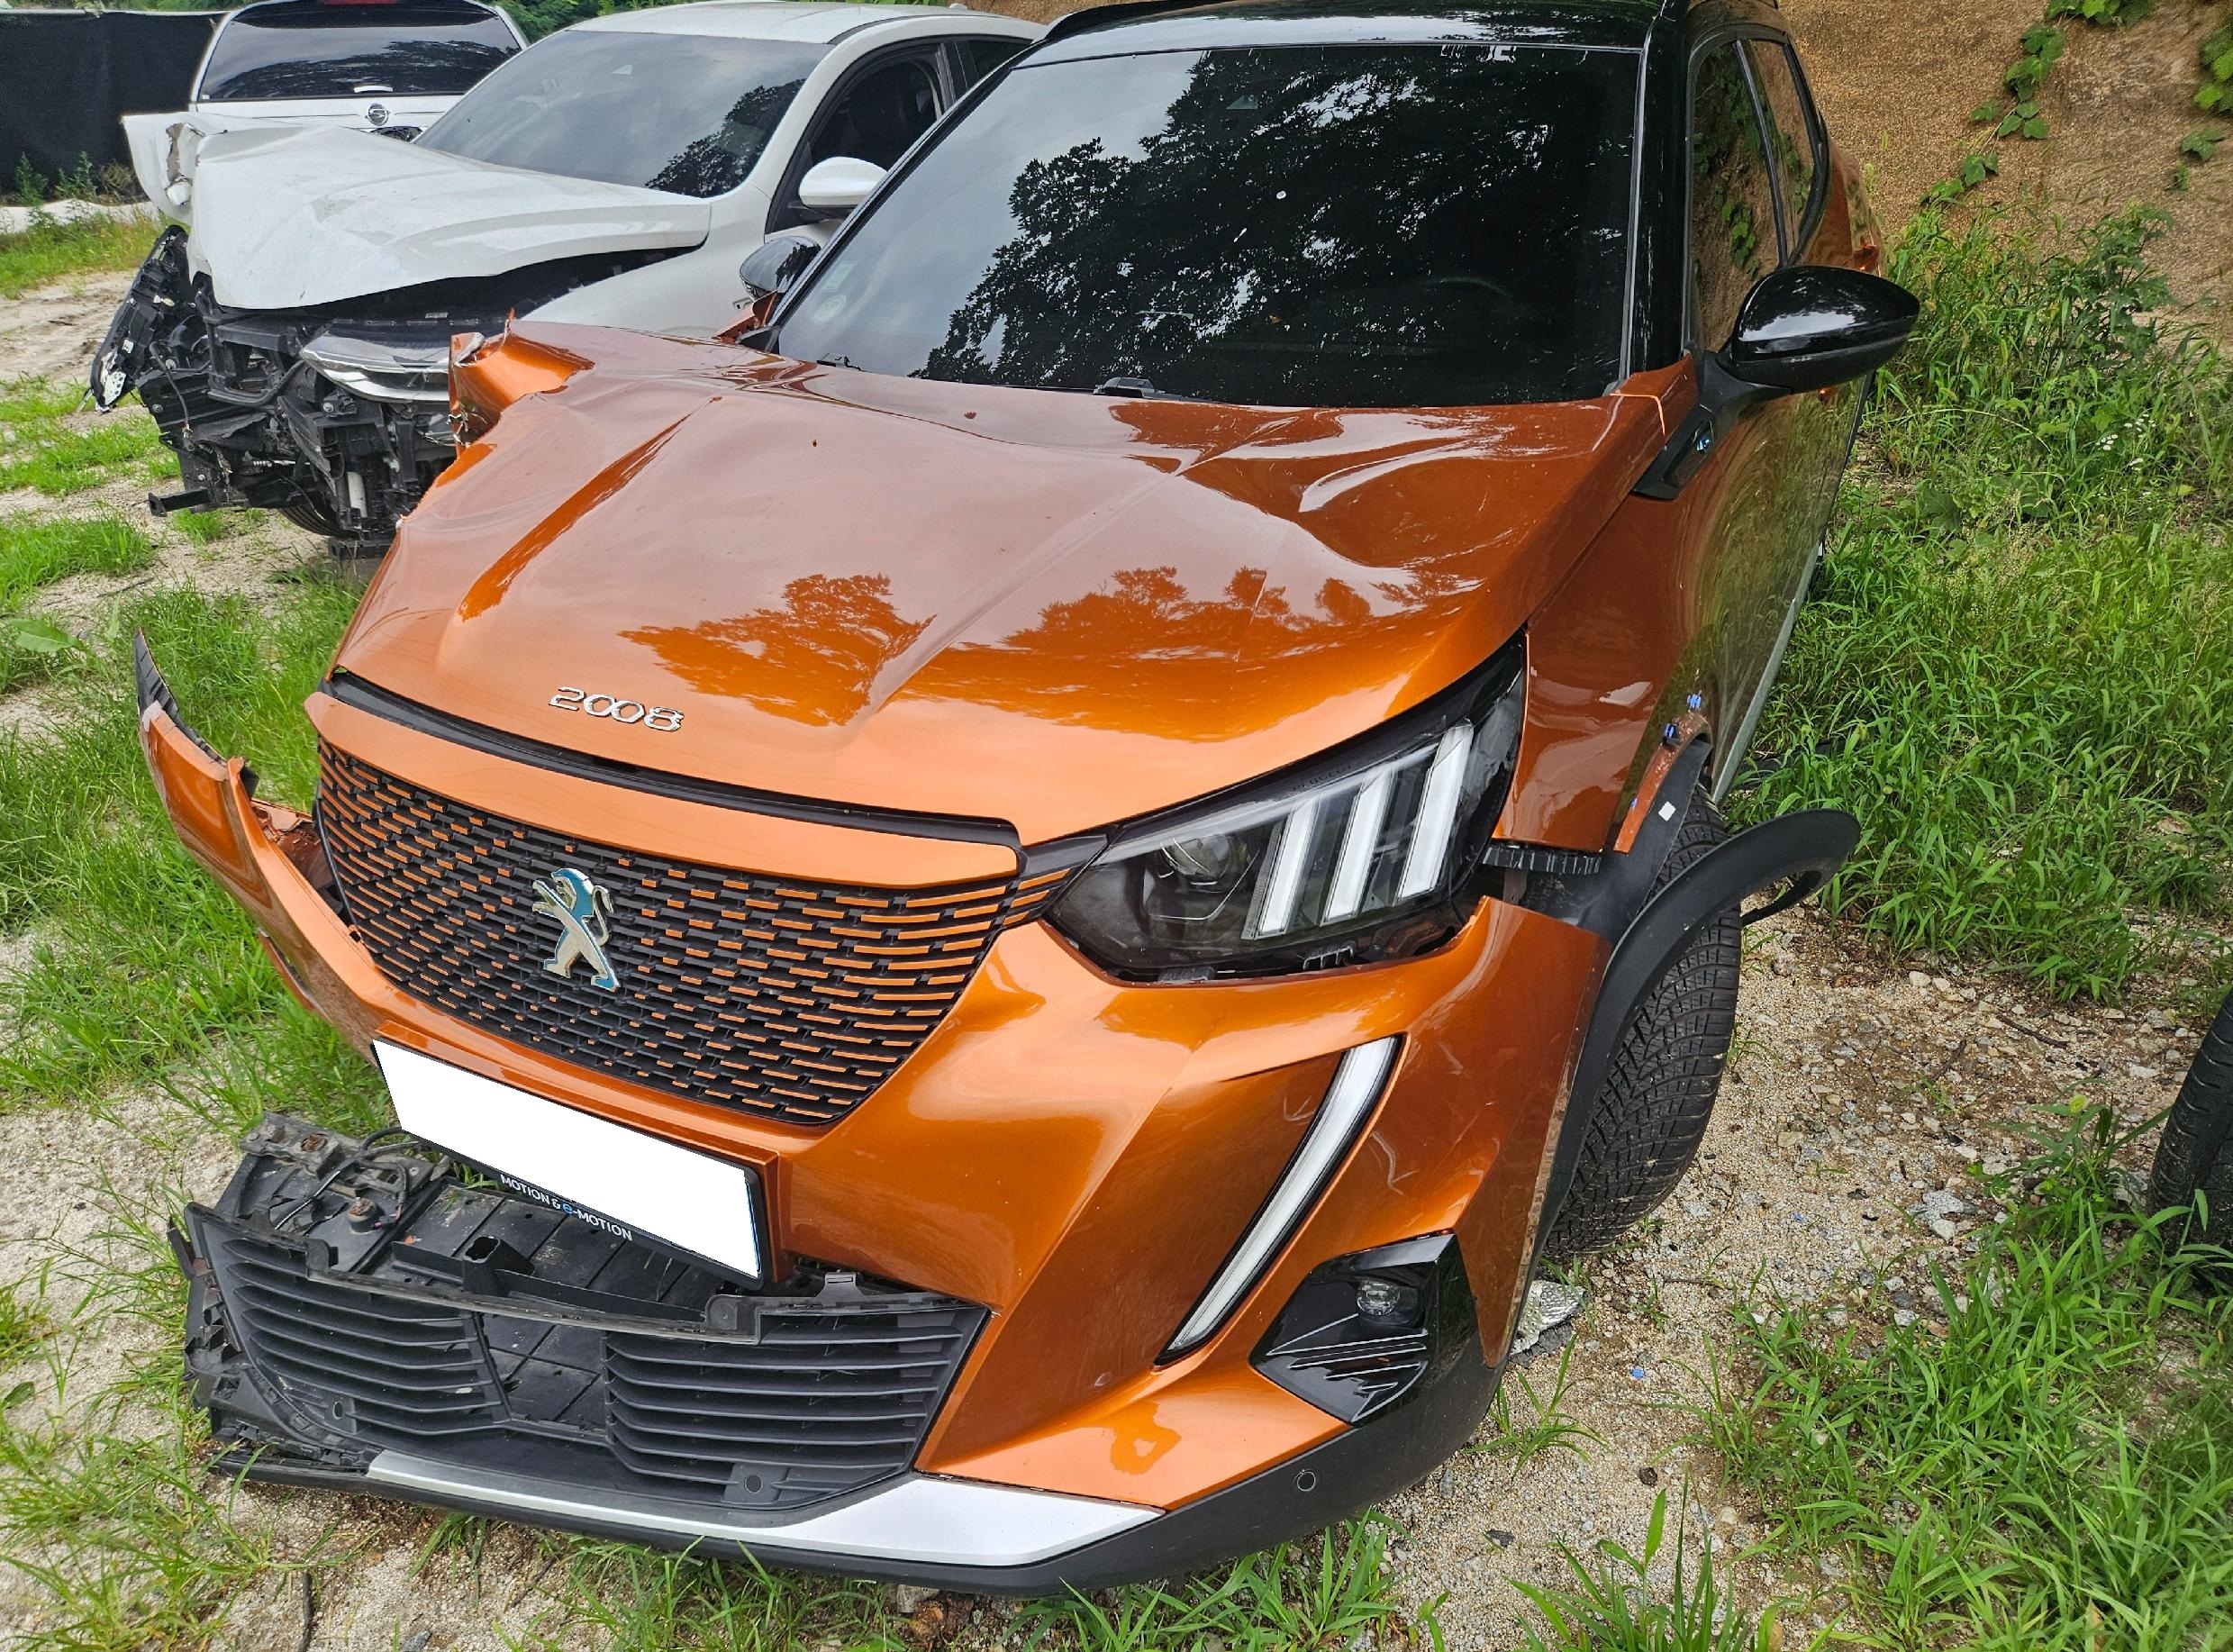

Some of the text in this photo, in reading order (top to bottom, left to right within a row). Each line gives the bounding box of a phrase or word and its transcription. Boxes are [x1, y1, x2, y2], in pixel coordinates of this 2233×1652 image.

[549, 686, 685, 731] 2008
[501, 1174, 632, 1241] MOTION & e-MOTION
